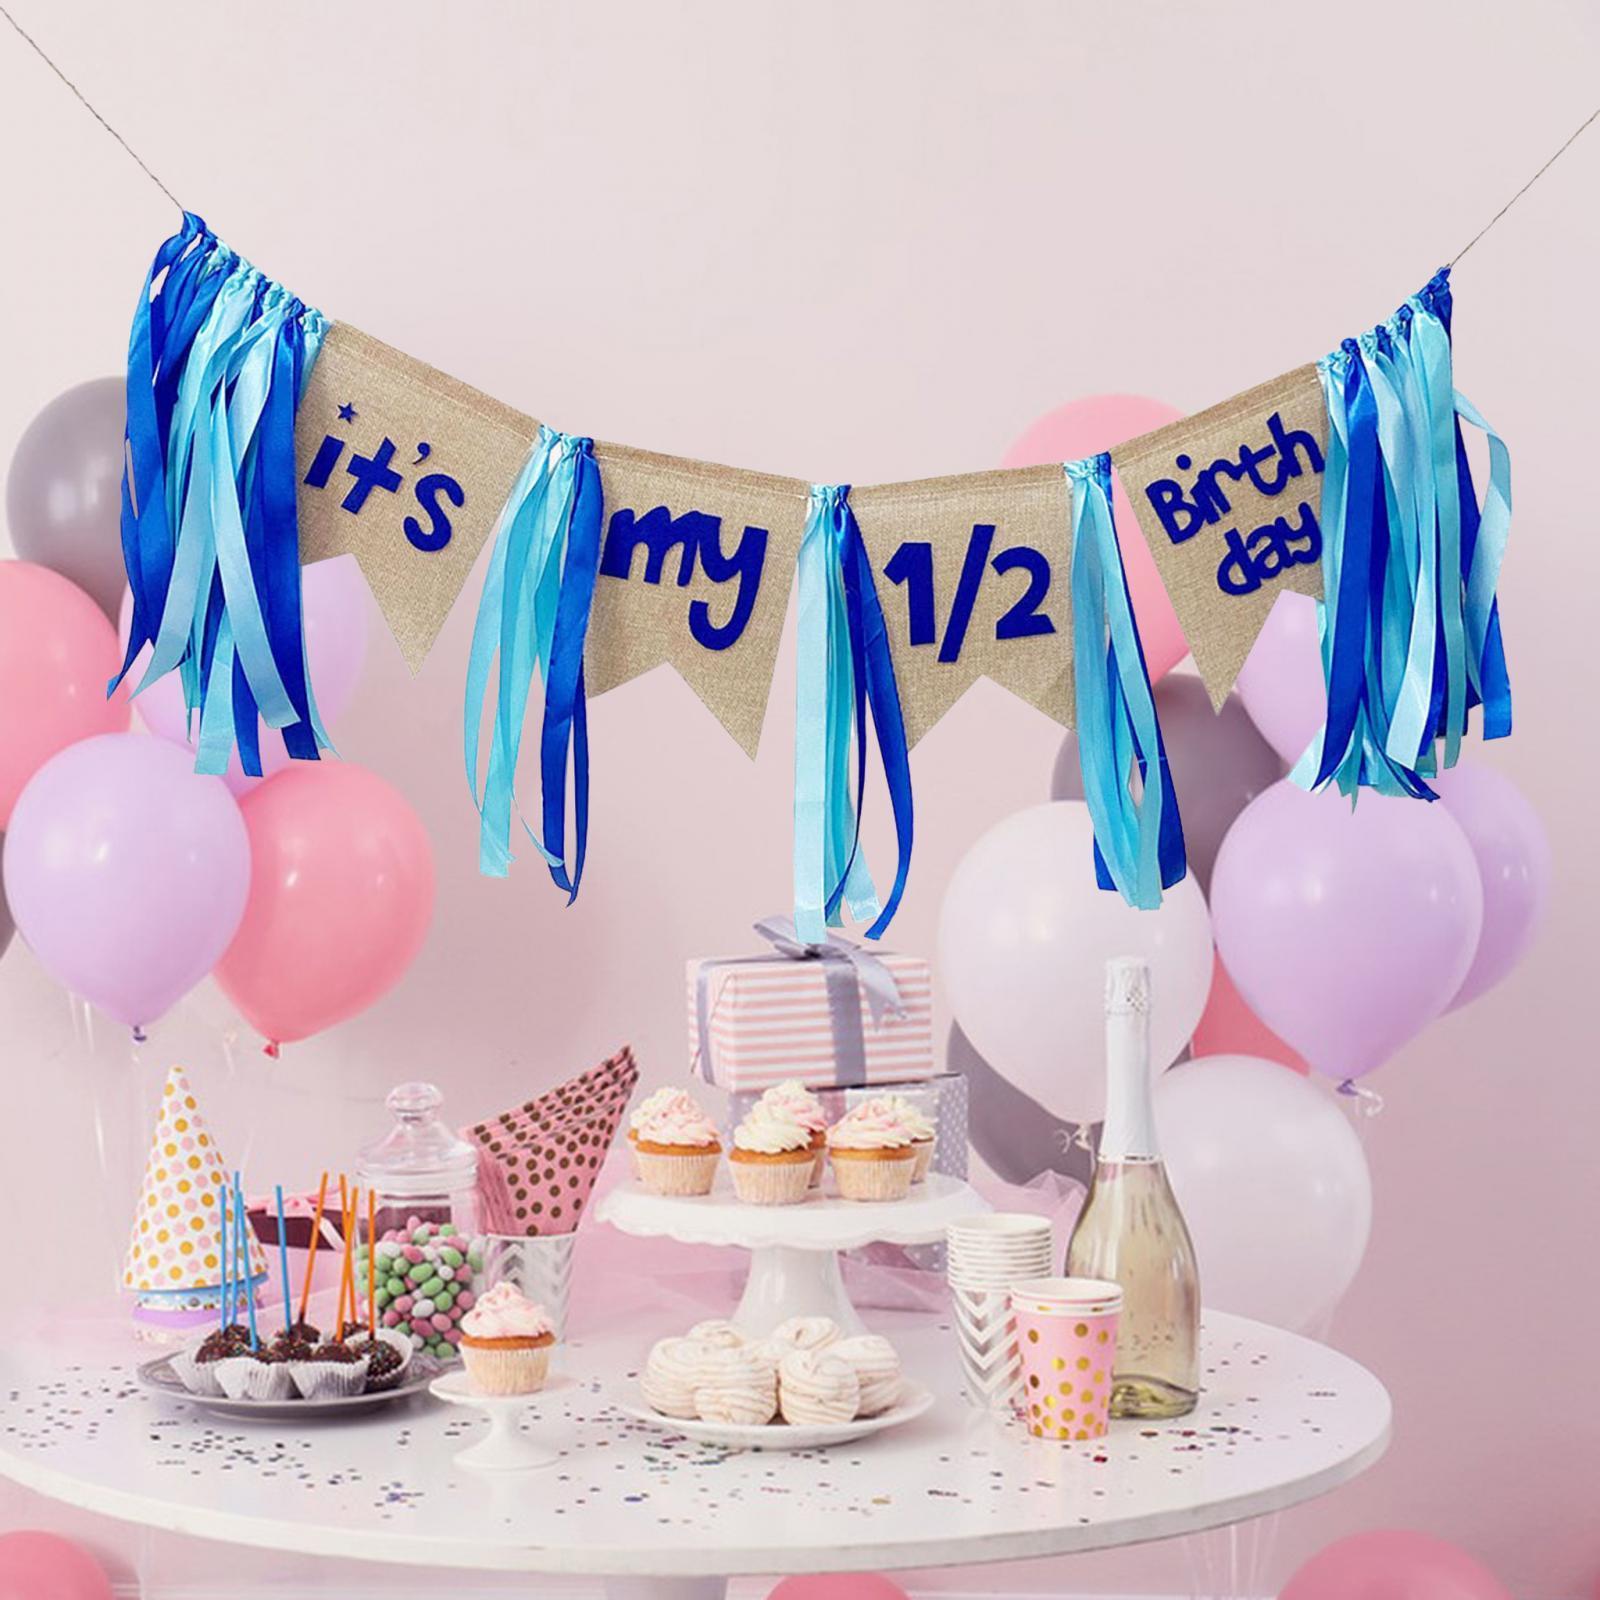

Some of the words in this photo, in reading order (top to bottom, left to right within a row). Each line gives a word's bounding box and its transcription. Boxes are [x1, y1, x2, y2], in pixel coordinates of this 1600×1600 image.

[303, 403, 465, 552] it's
[598, 506, 769, 651] my
[882, 524, 1056, 664] 1/2
[1145, 411, 1326, 545] Birth
[1216, 501, 1323, 596] day
